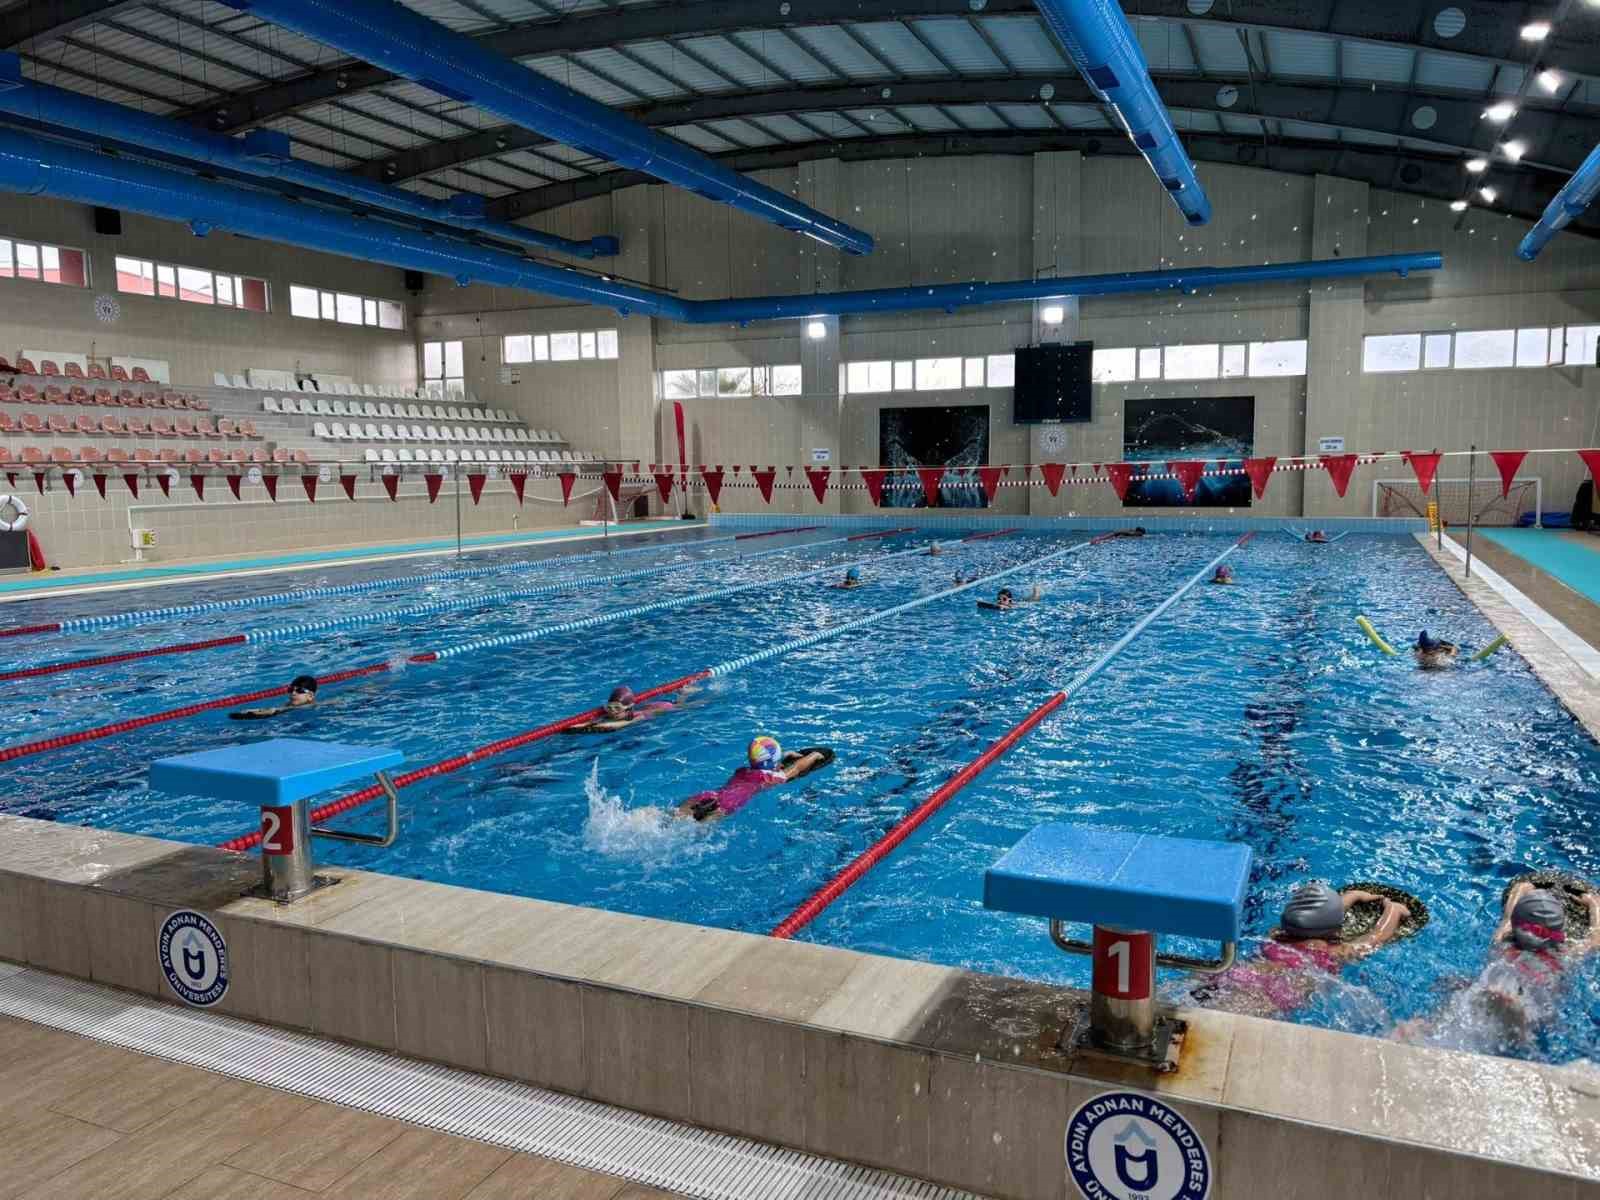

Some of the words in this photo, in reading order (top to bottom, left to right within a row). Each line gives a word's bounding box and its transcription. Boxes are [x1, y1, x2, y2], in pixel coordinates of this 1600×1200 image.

[261, 811, 281, 850] 2
[162, 931, 171, 968] AYDIN
[168, 915, 197, 933] ADNAN
[1107, 940, 1130, 993] 1
[1071, 1122, 1089, 1173] AYDIN
[1086, 1098, 1145, 1124] ADNAN
[1149, 1105, 1205, 1192] MENDERES
